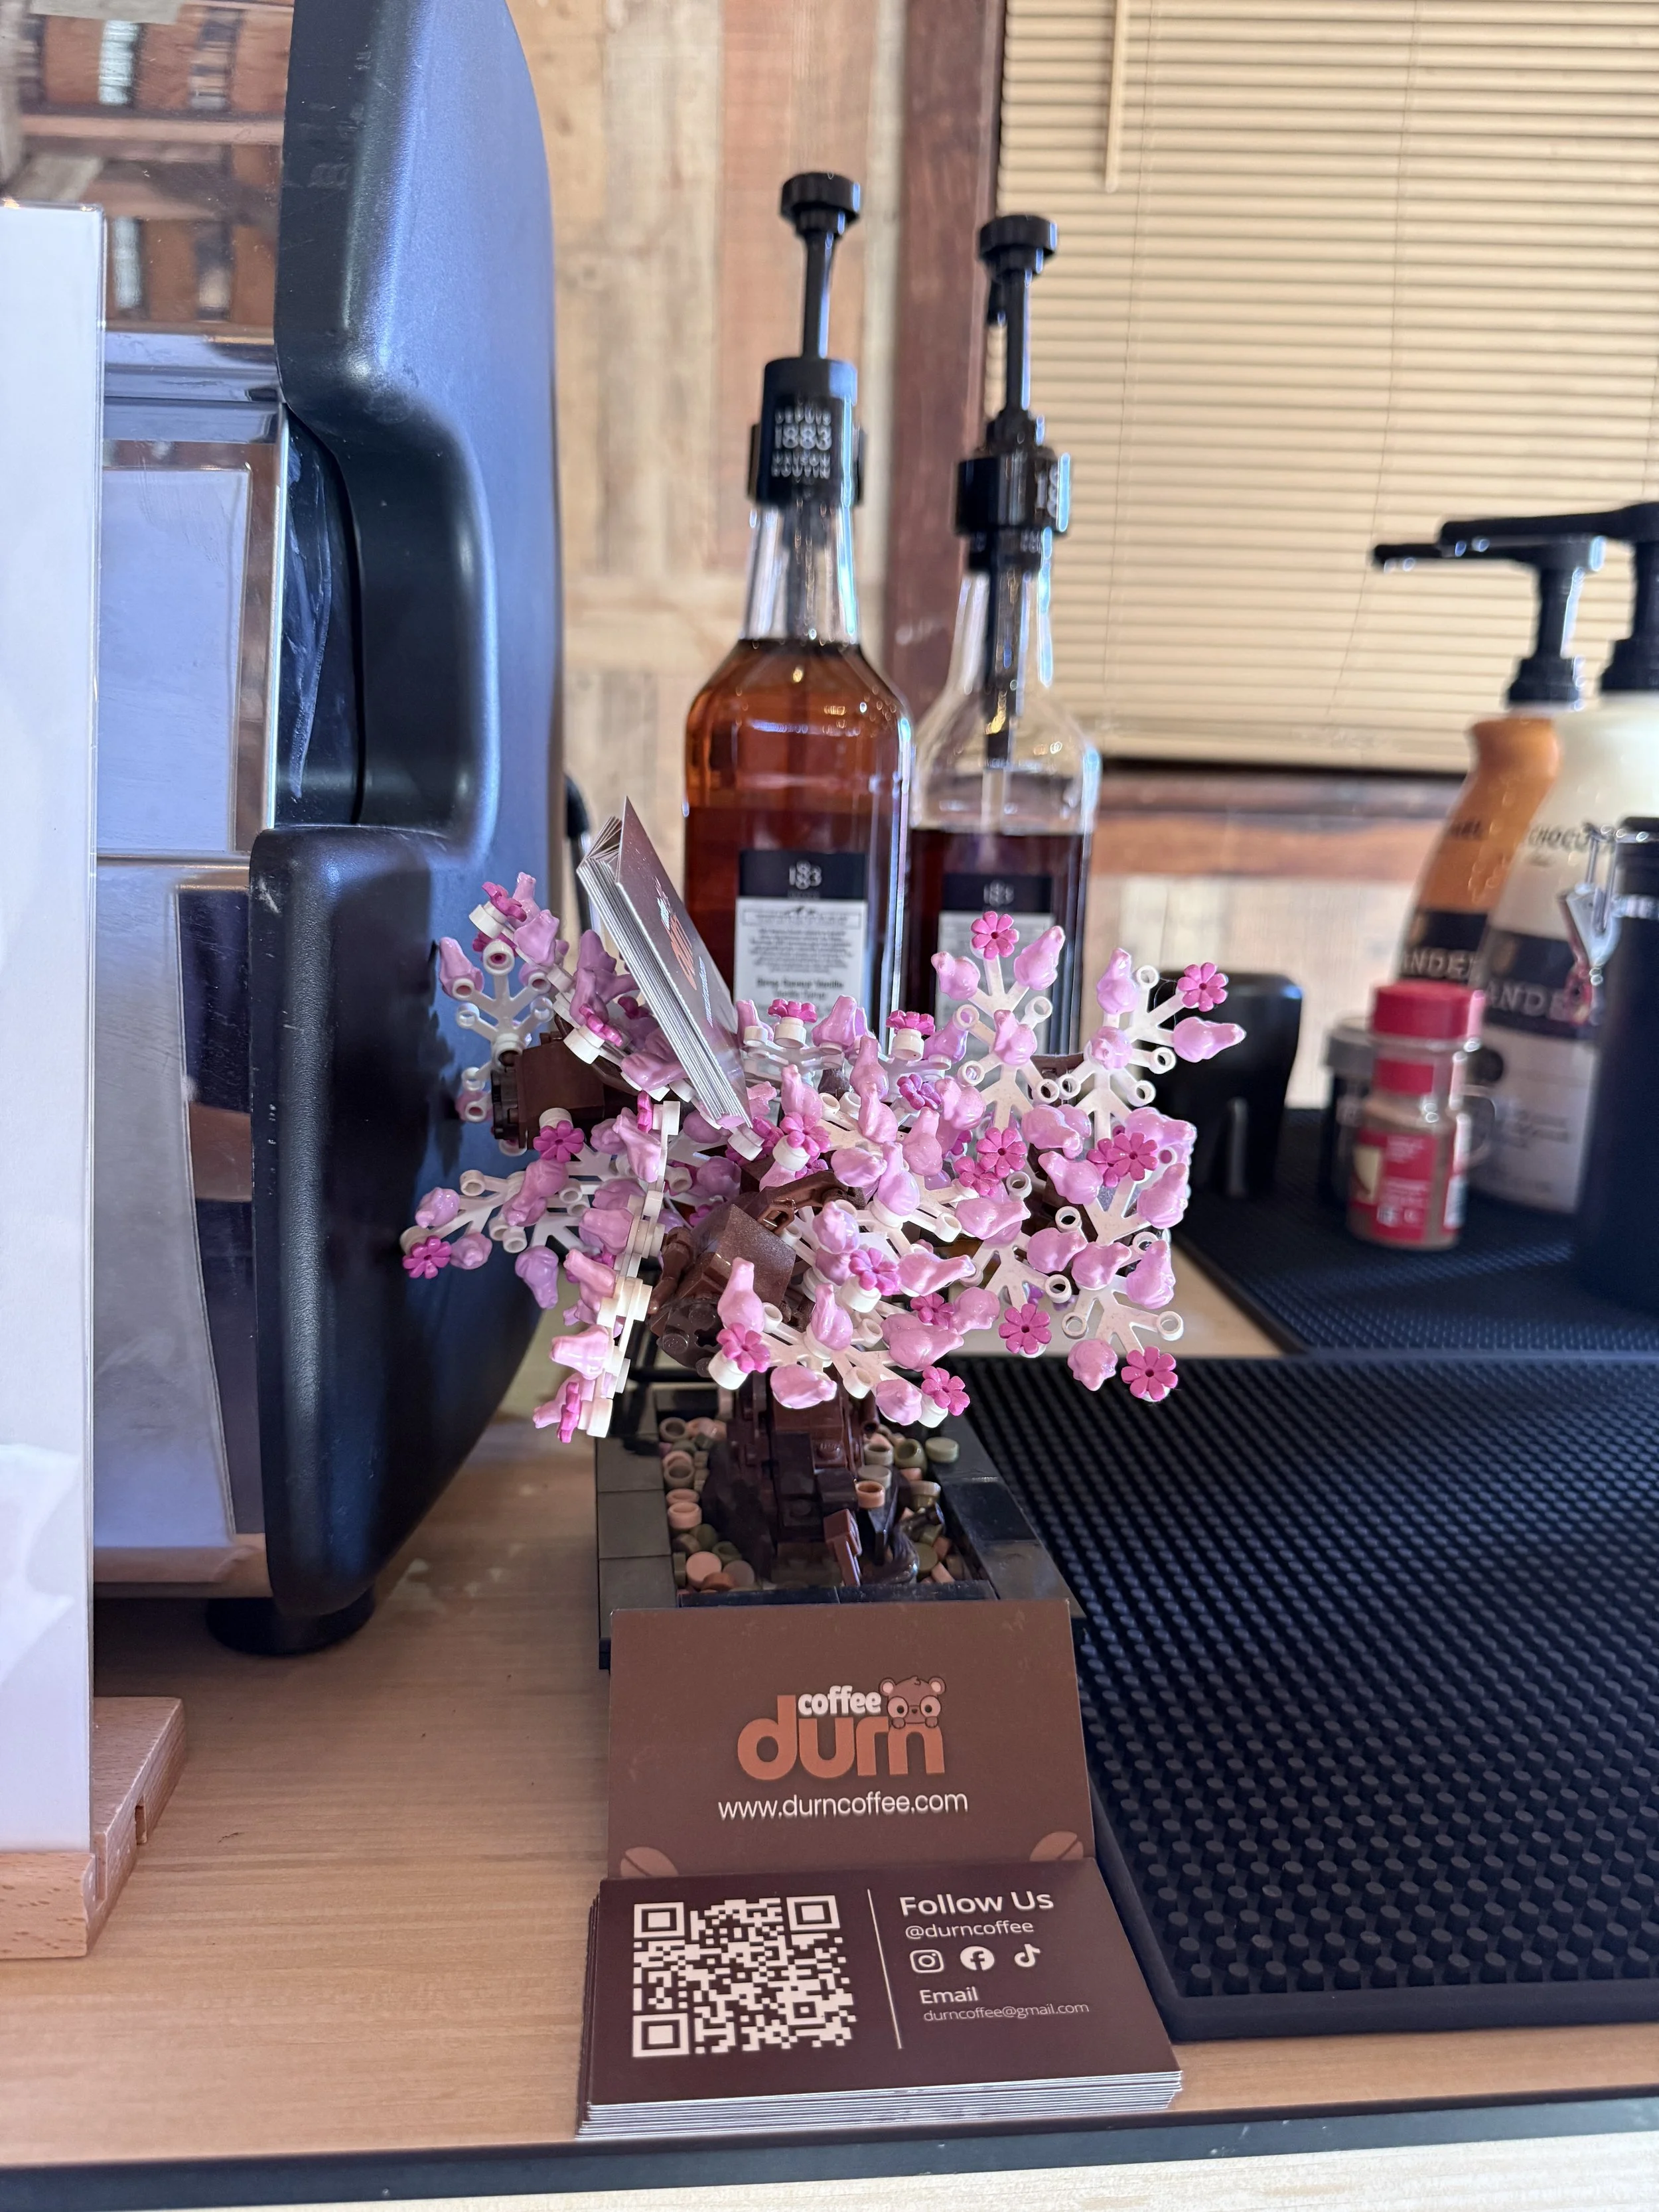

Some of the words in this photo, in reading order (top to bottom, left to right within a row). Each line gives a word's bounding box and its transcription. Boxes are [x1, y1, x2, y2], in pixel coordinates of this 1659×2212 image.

[774, 423, 833, 451] 1883
[798, 1685, 882, 1716] coffee
[737, 1694, 945, 1780] durn
[718, 1791, 969, 1820] www.durncoffee.com
[899, 1893, 1003, 1917] Follow
[1011, 1890, 1054, 1911] Us
[905, 1919, 1035, 1940] @durncoffee
[919, 1986, 979, 2004] Email
[923, 2003, 1090, 2022] durncoffee@gmail.com
